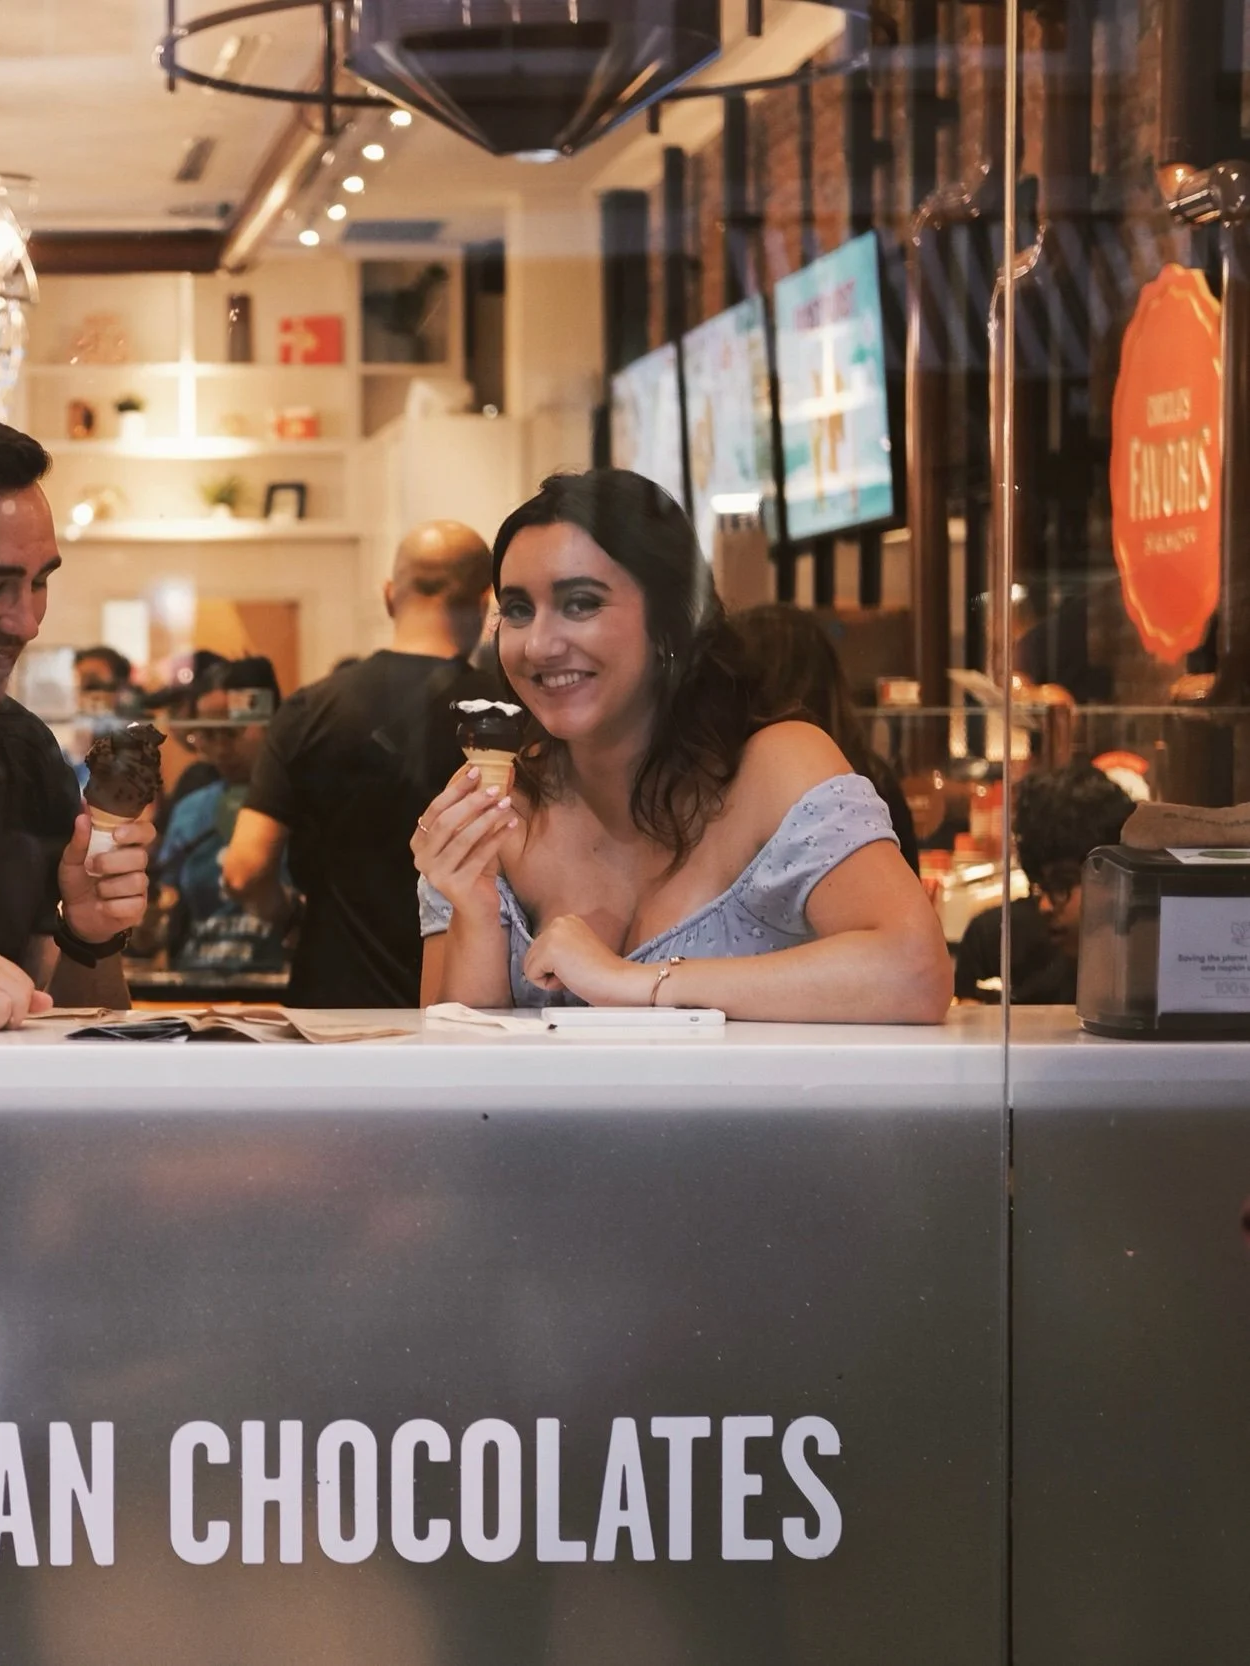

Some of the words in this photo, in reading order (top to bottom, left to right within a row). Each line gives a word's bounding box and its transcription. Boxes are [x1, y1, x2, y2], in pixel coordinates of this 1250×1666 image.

[1178, 953, 1205, 965] Saving
[1207, 953, 1220, 963] the
[1221, 953, 1248, 966] planet
[169, 1415, 842, 1565] CHOCOLATES
